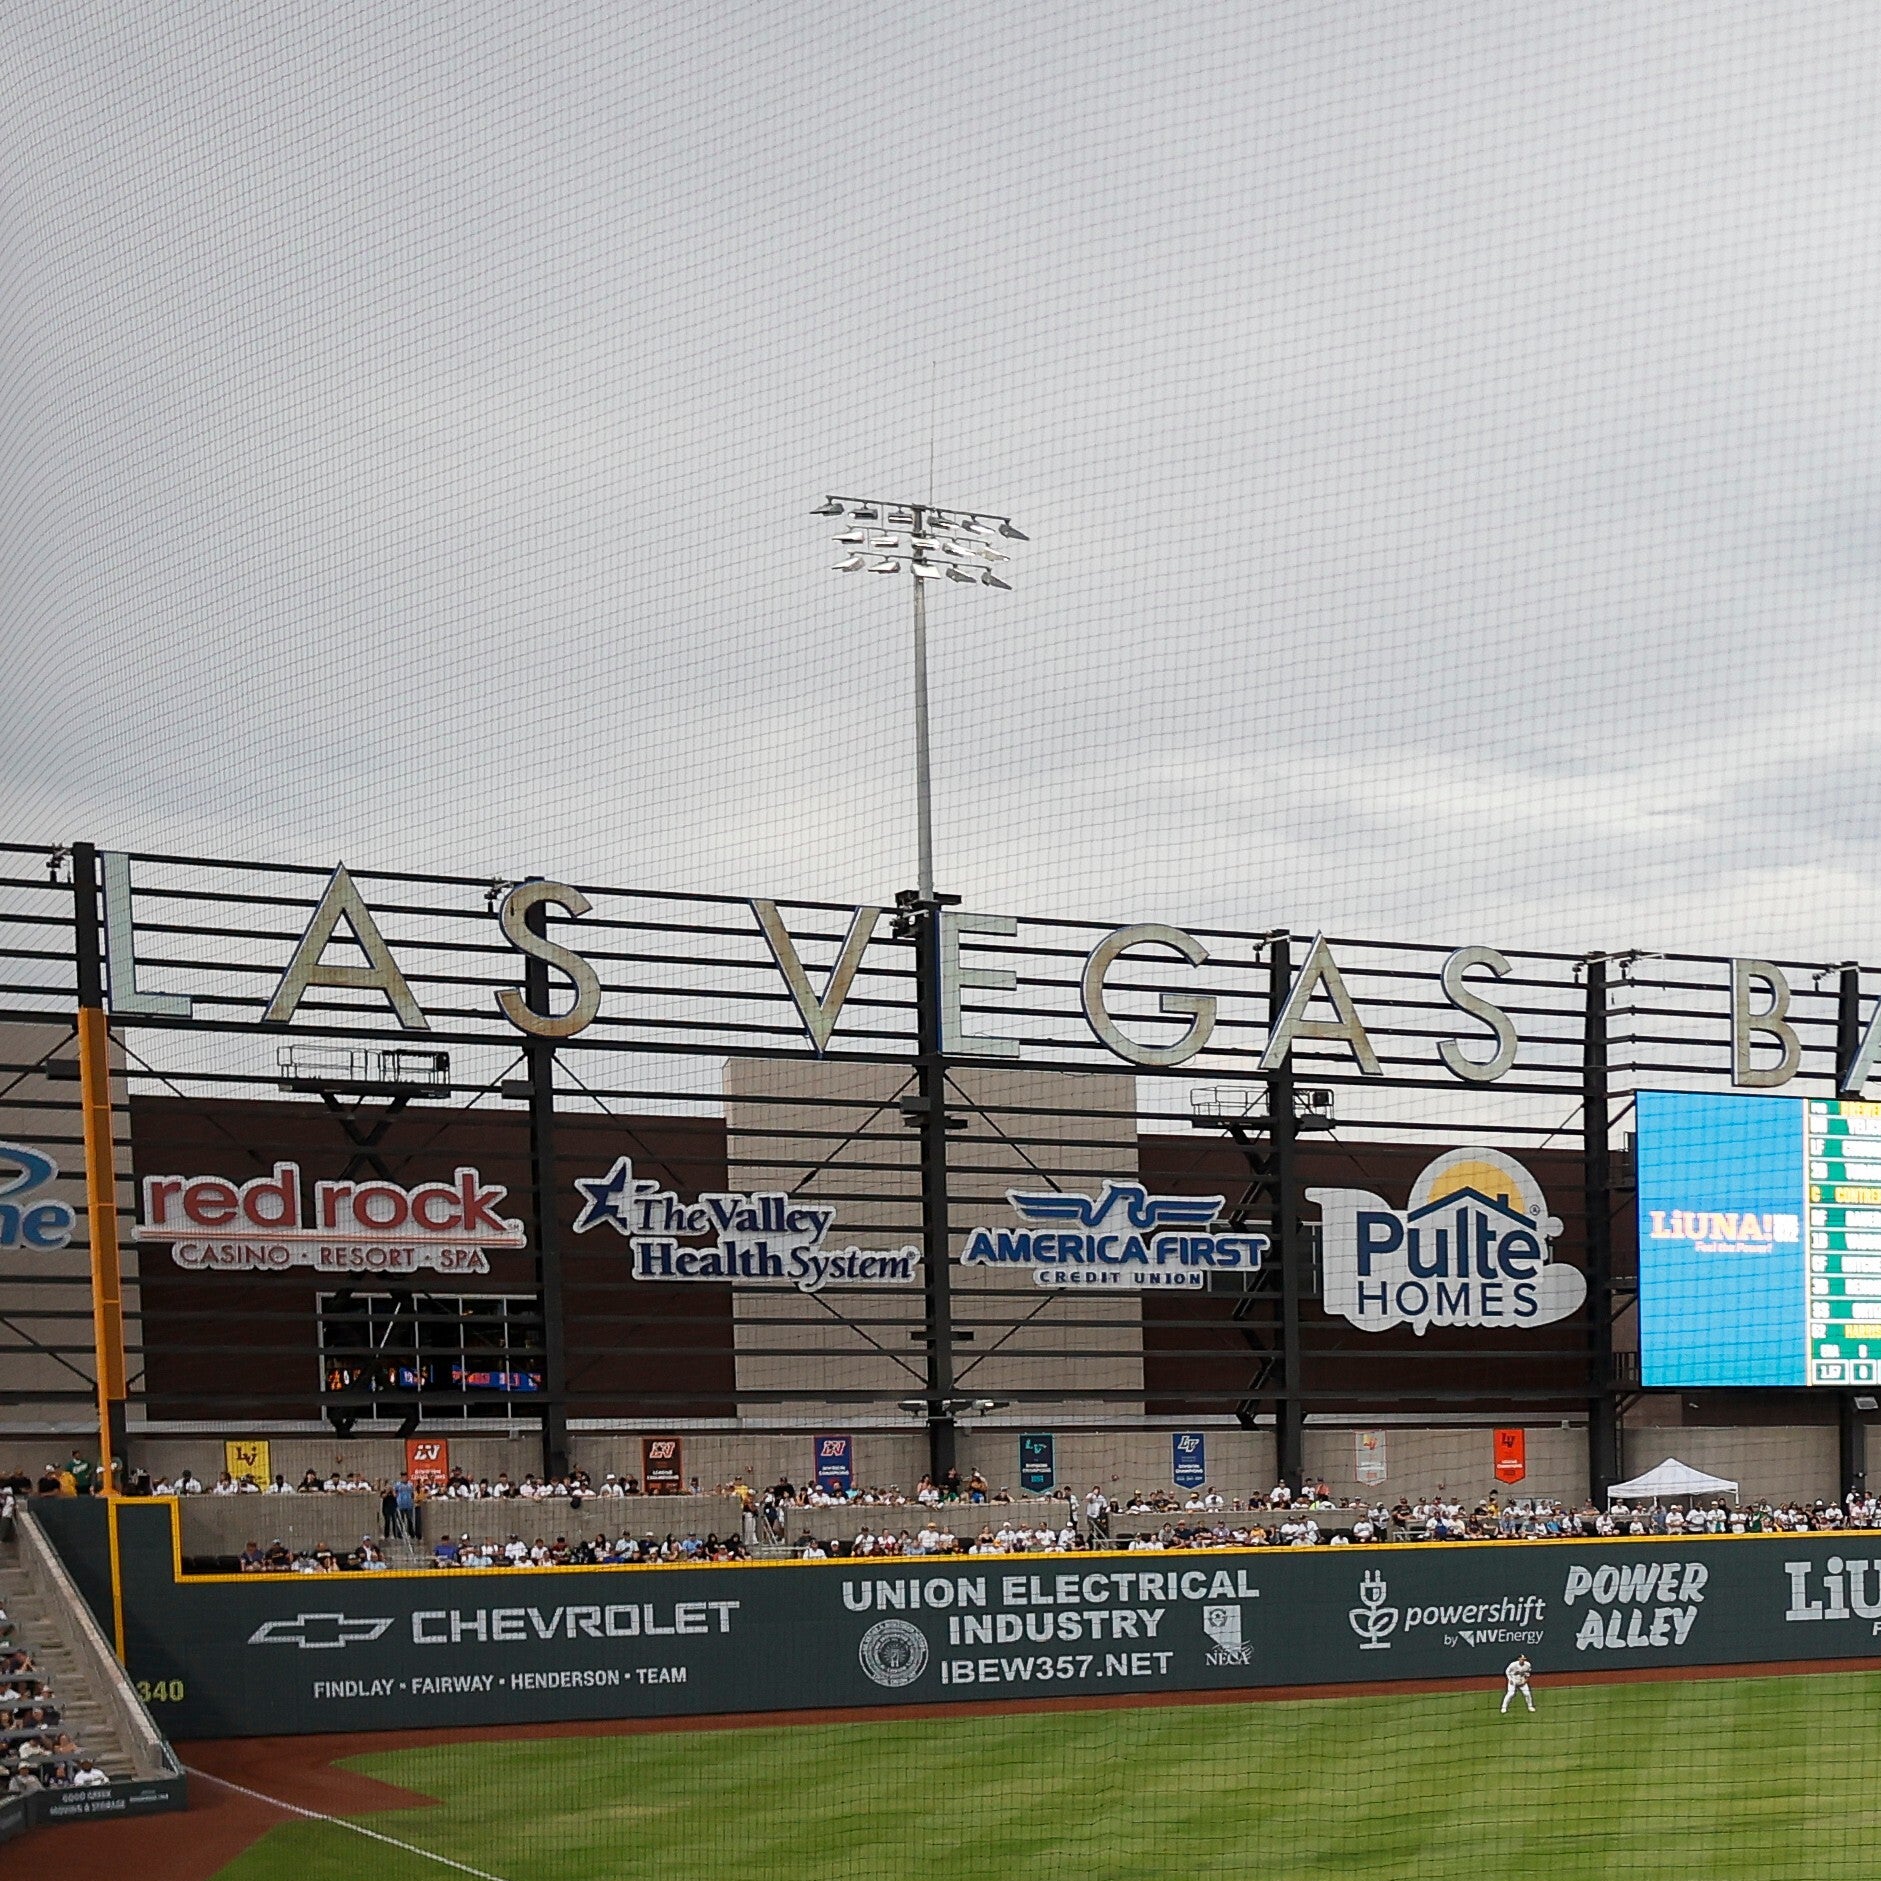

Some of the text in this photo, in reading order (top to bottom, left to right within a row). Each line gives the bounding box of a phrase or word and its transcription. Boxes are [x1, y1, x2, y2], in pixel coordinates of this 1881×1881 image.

[103, 851, 602, 1038] LAS
[751, 898, 1518, 1083] VEGAS
[150, 1169, 507, 1231] red rock
[636, 1196, 834, 1243] The Valley
[1650, 1209, 1773, 1240] LiUNA!
[180, 1244, 486, 1269] CASINO RESORT SPA
[639, 1241, 787, 1277] Health
[966, 1234, 1269, 1267] AMERICA FIRST
[1356, 1204, 1541, 1278] Pulte
[1039, 1271, 1202, 1286] CREDIT UNION
[1357, 1280, 1539, 1318] HOMES
[1178, 1435, 1200, 1453] LV
[842, 1569, 1260, 1612] UNION ELECTRICAL
[1564, 1562, 1710, 1606] POWER
[411, 1600, 741, 1645] CHEVROLET
[949, 1608, 1166, 1646] INDUSTRY
[1405, 1595, 1546, 1632] powershift
[1576, 1604, 1699, 1651] ALLEY
[1444, 1628, 1544, 1647] by NVEnergy
[941, 1651, 1175, 1685] IBEW357.NET
[1205, 1652, 1251, 1667] NECA
[139, 1679, 184, 1702] 340
[313, 1666, 687, 1699] FINDLAY FAIRWAY HENDERSON TEAM
